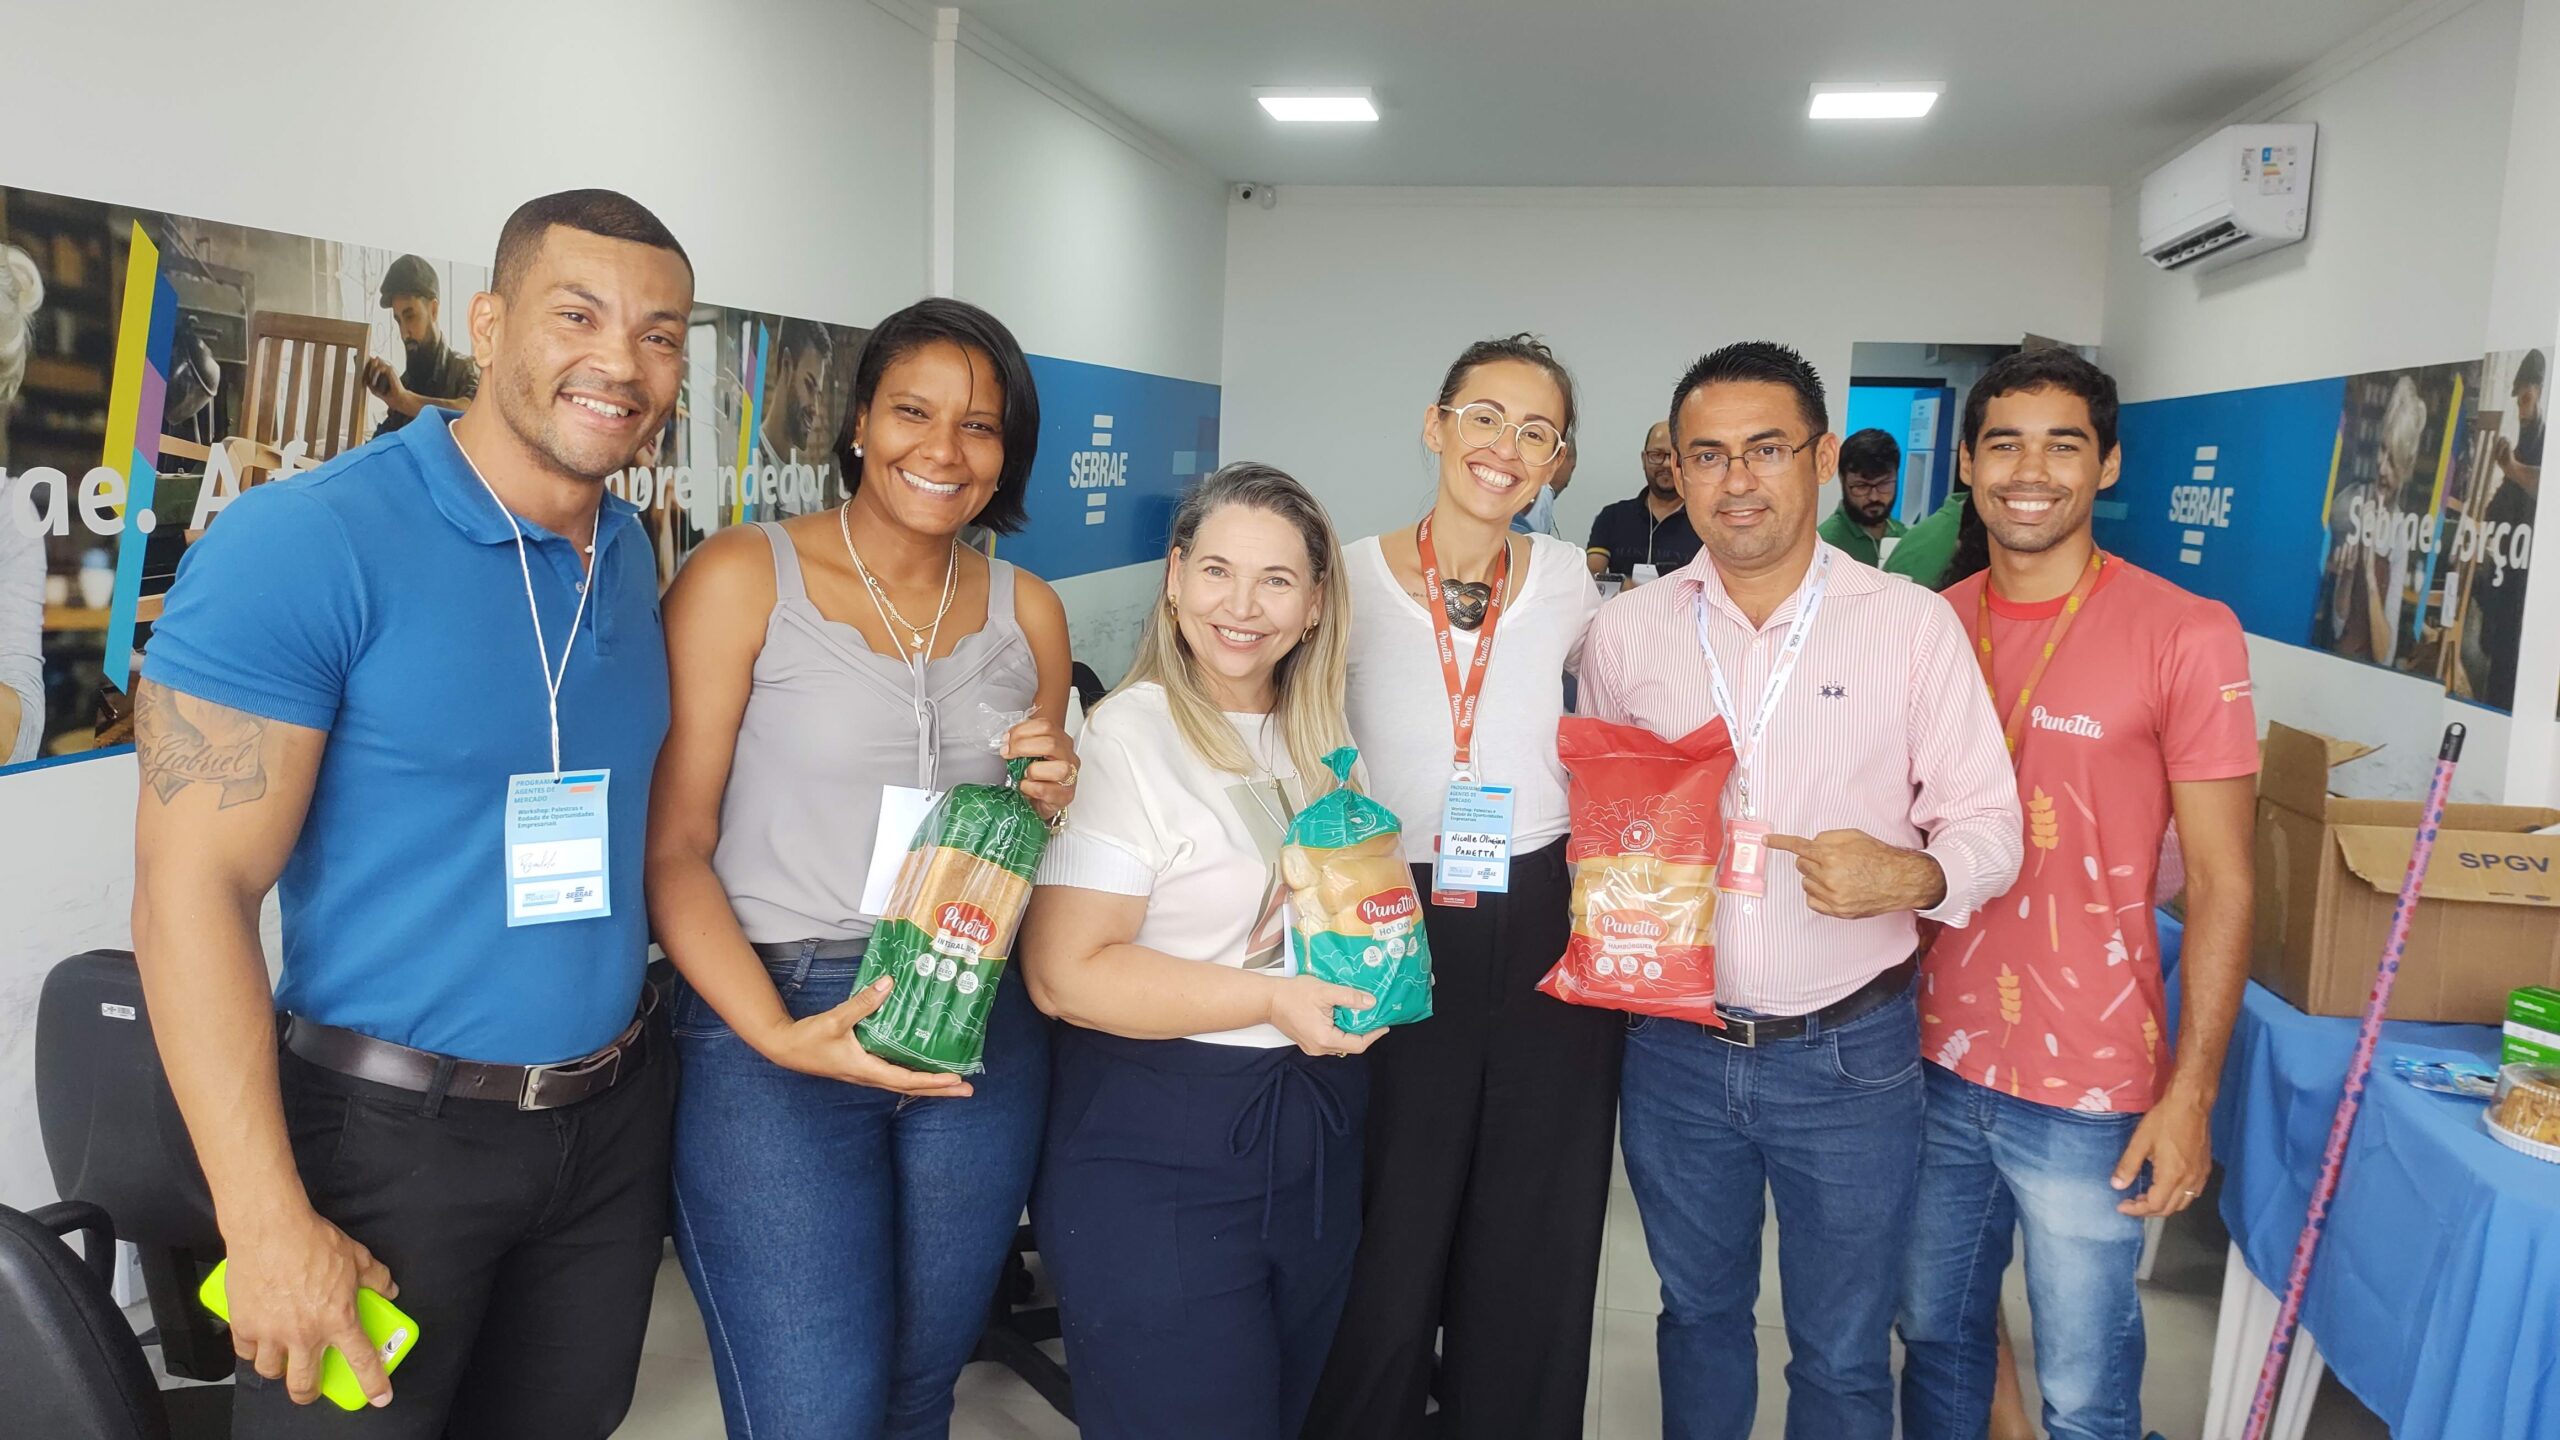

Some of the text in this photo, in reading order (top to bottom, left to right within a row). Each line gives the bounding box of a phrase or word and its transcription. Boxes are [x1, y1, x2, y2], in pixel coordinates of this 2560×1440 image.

[1069, 451, 1129, 489] SEBRAE
[2168, 485, 2235, 529] SEBRAE
[1475, 636, 1491, 667] Panetta
[1460, 694, 1476, 728] Panetta
[2031, 705, 2104, 740] Panetta
[514, 787, 545, 795] AGENTES
[514, 795, 548, 804] MERCADO
[1451, 833, 1477, 843] Nicolle
[1455, 845, 1495, 858] PANETTA
[2458, 852, 2551, 874] SPGV
[565, 890, 593, 899] SEBRAE
[1362, 894, 1415, 920] Panetta
[1379, 925, 1396, 936] Hot
[1601, 914, 1662, 937] Panetta
